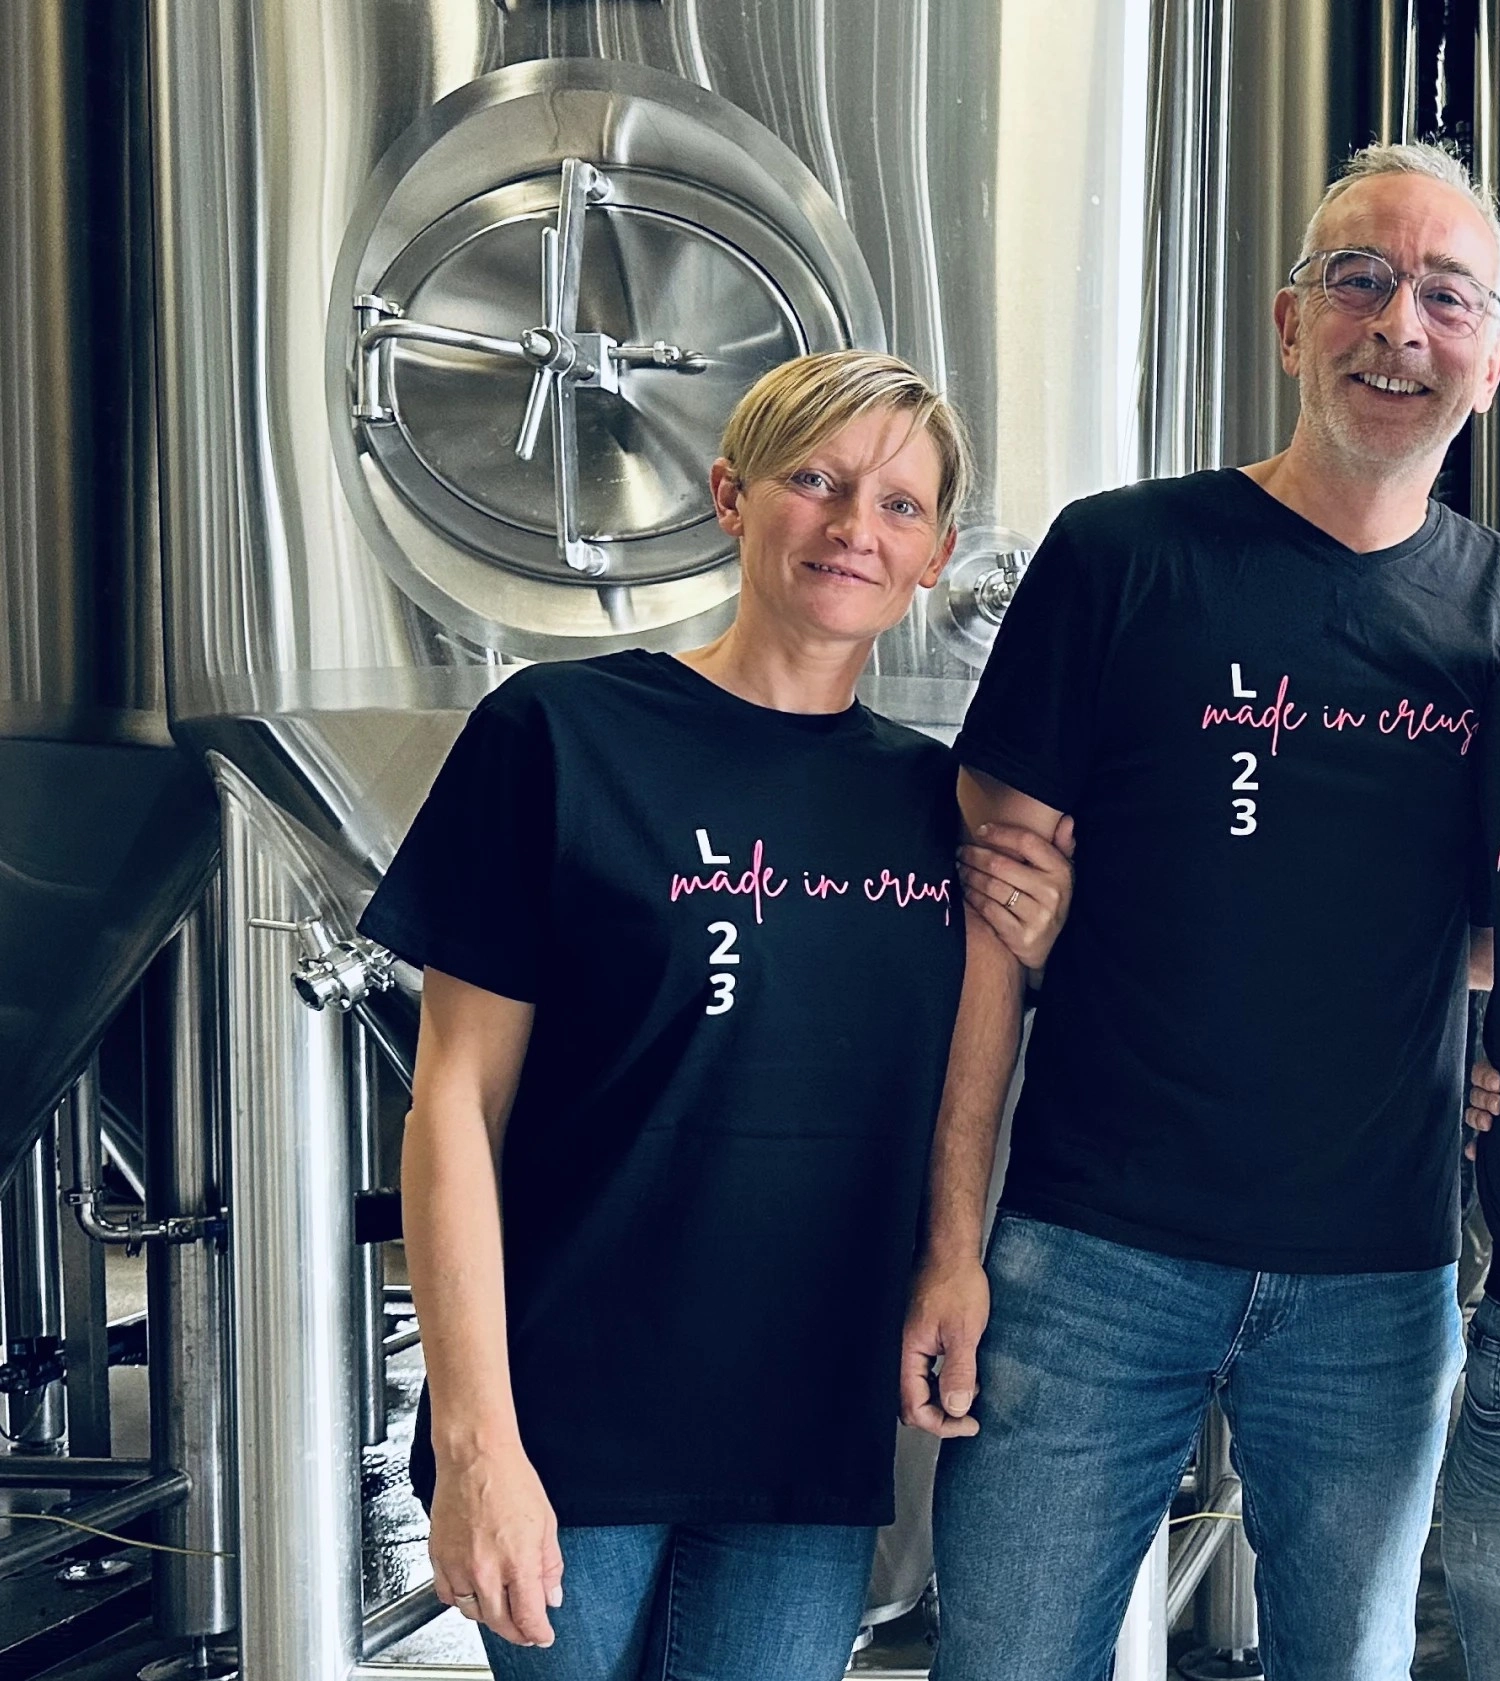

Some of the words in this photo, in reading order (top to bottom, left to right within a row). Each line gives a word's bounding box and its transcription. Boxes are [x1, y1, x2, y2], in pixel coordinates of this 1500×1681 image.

[1230, 663, 1257, 698] L
[1201, 675, 1308, 756] made
[1323, 705, 1366, 731] in
[1378, 699, 1479, 756] creus
[695, 828, 731, 865] L
[670, 839, 788, 925] made
[803, 871, 849, 900] in
[864, 869, 951, 926] creus
